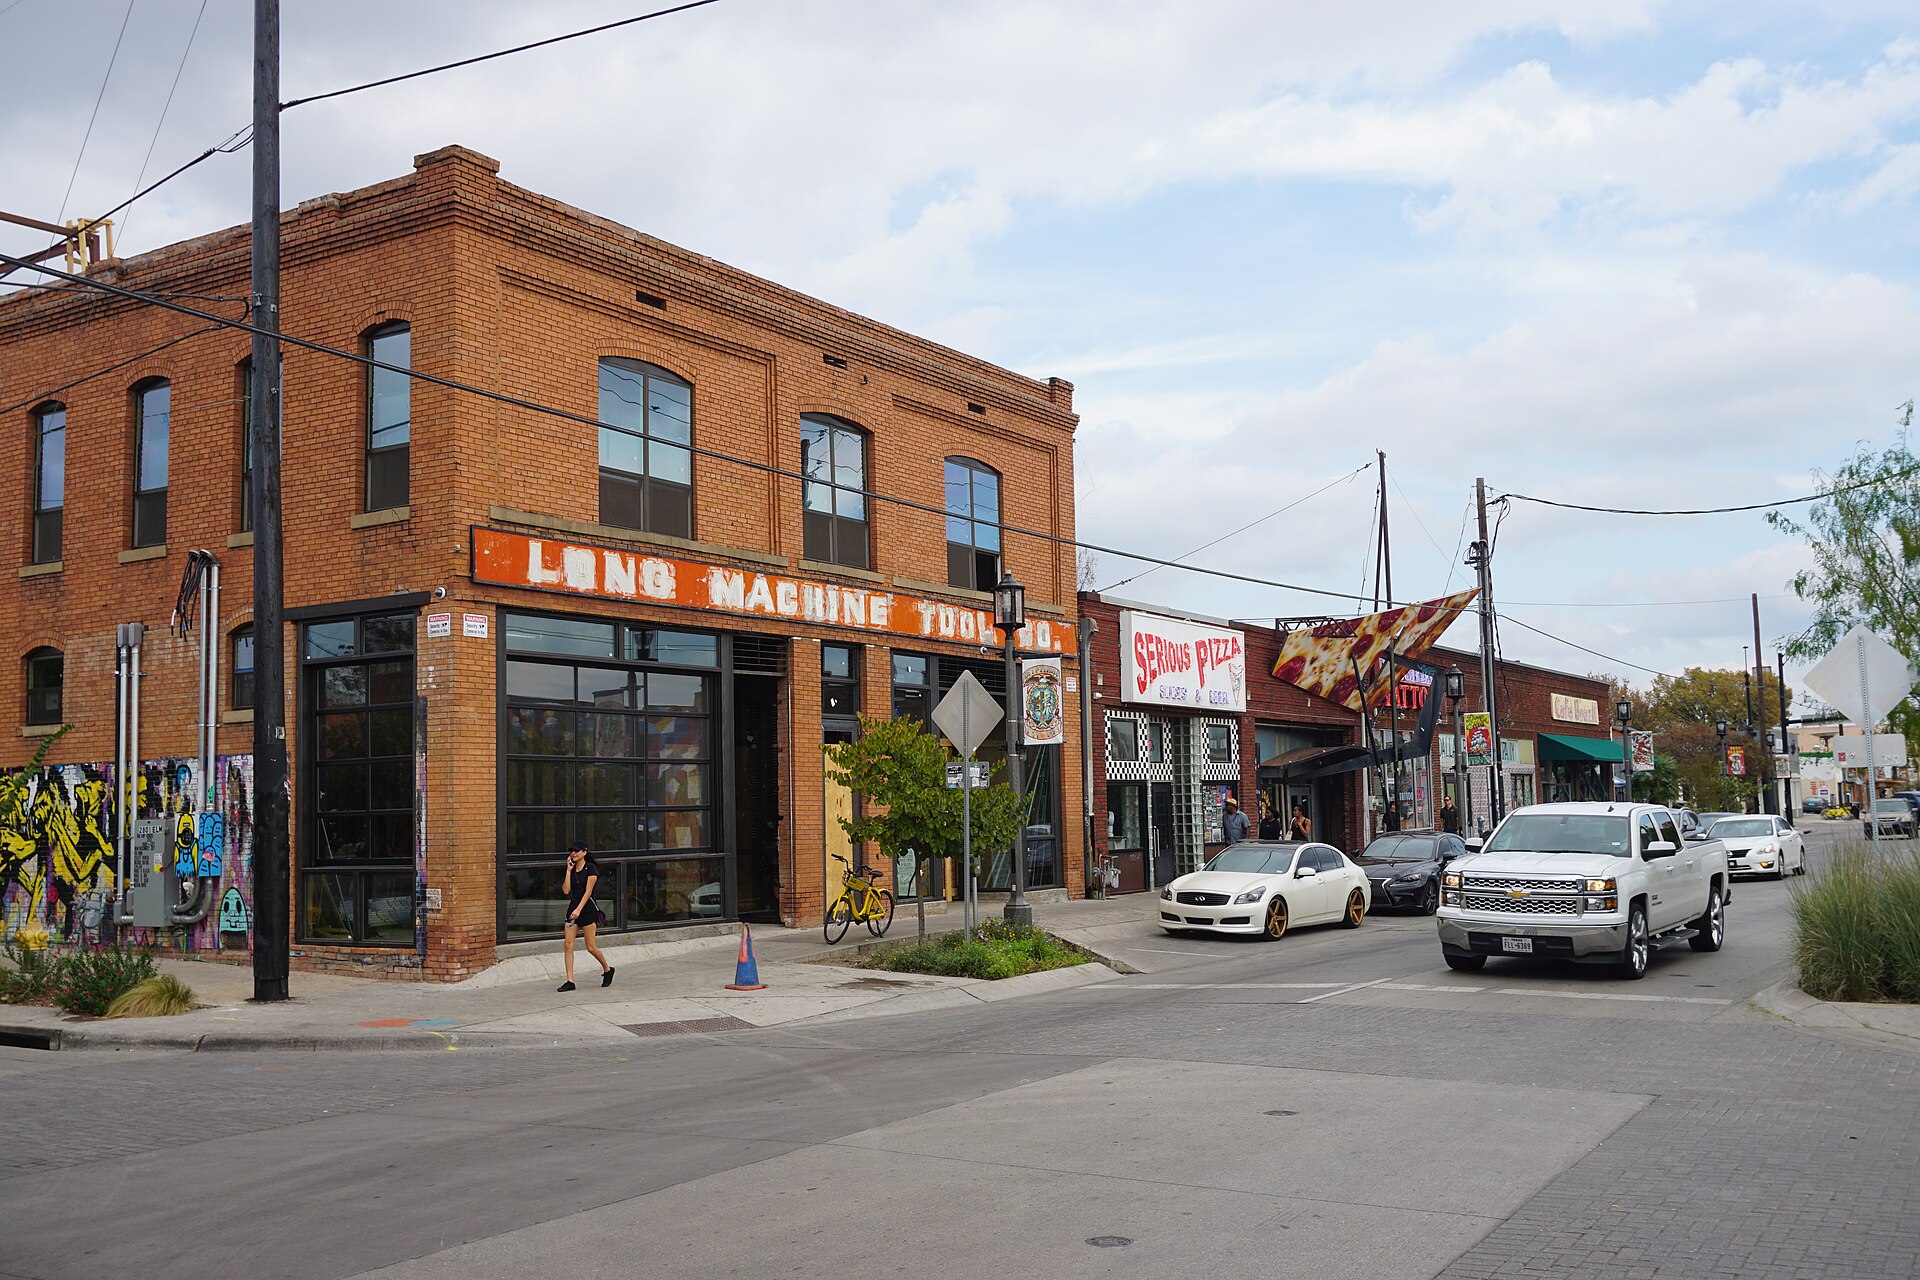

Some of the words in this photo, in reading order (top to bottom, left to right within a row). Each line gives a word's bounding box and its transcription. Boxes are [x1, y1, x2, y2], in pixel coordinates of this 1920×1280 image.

[527, 539, 676, 600] LONG
[707, 566, 891, 627] MACHINE
[916, 600, 998, 646] TOOL
[1134, 631, 1191, 695] SERIOUS
[1195, 636, 1242, 690] PIZZA
